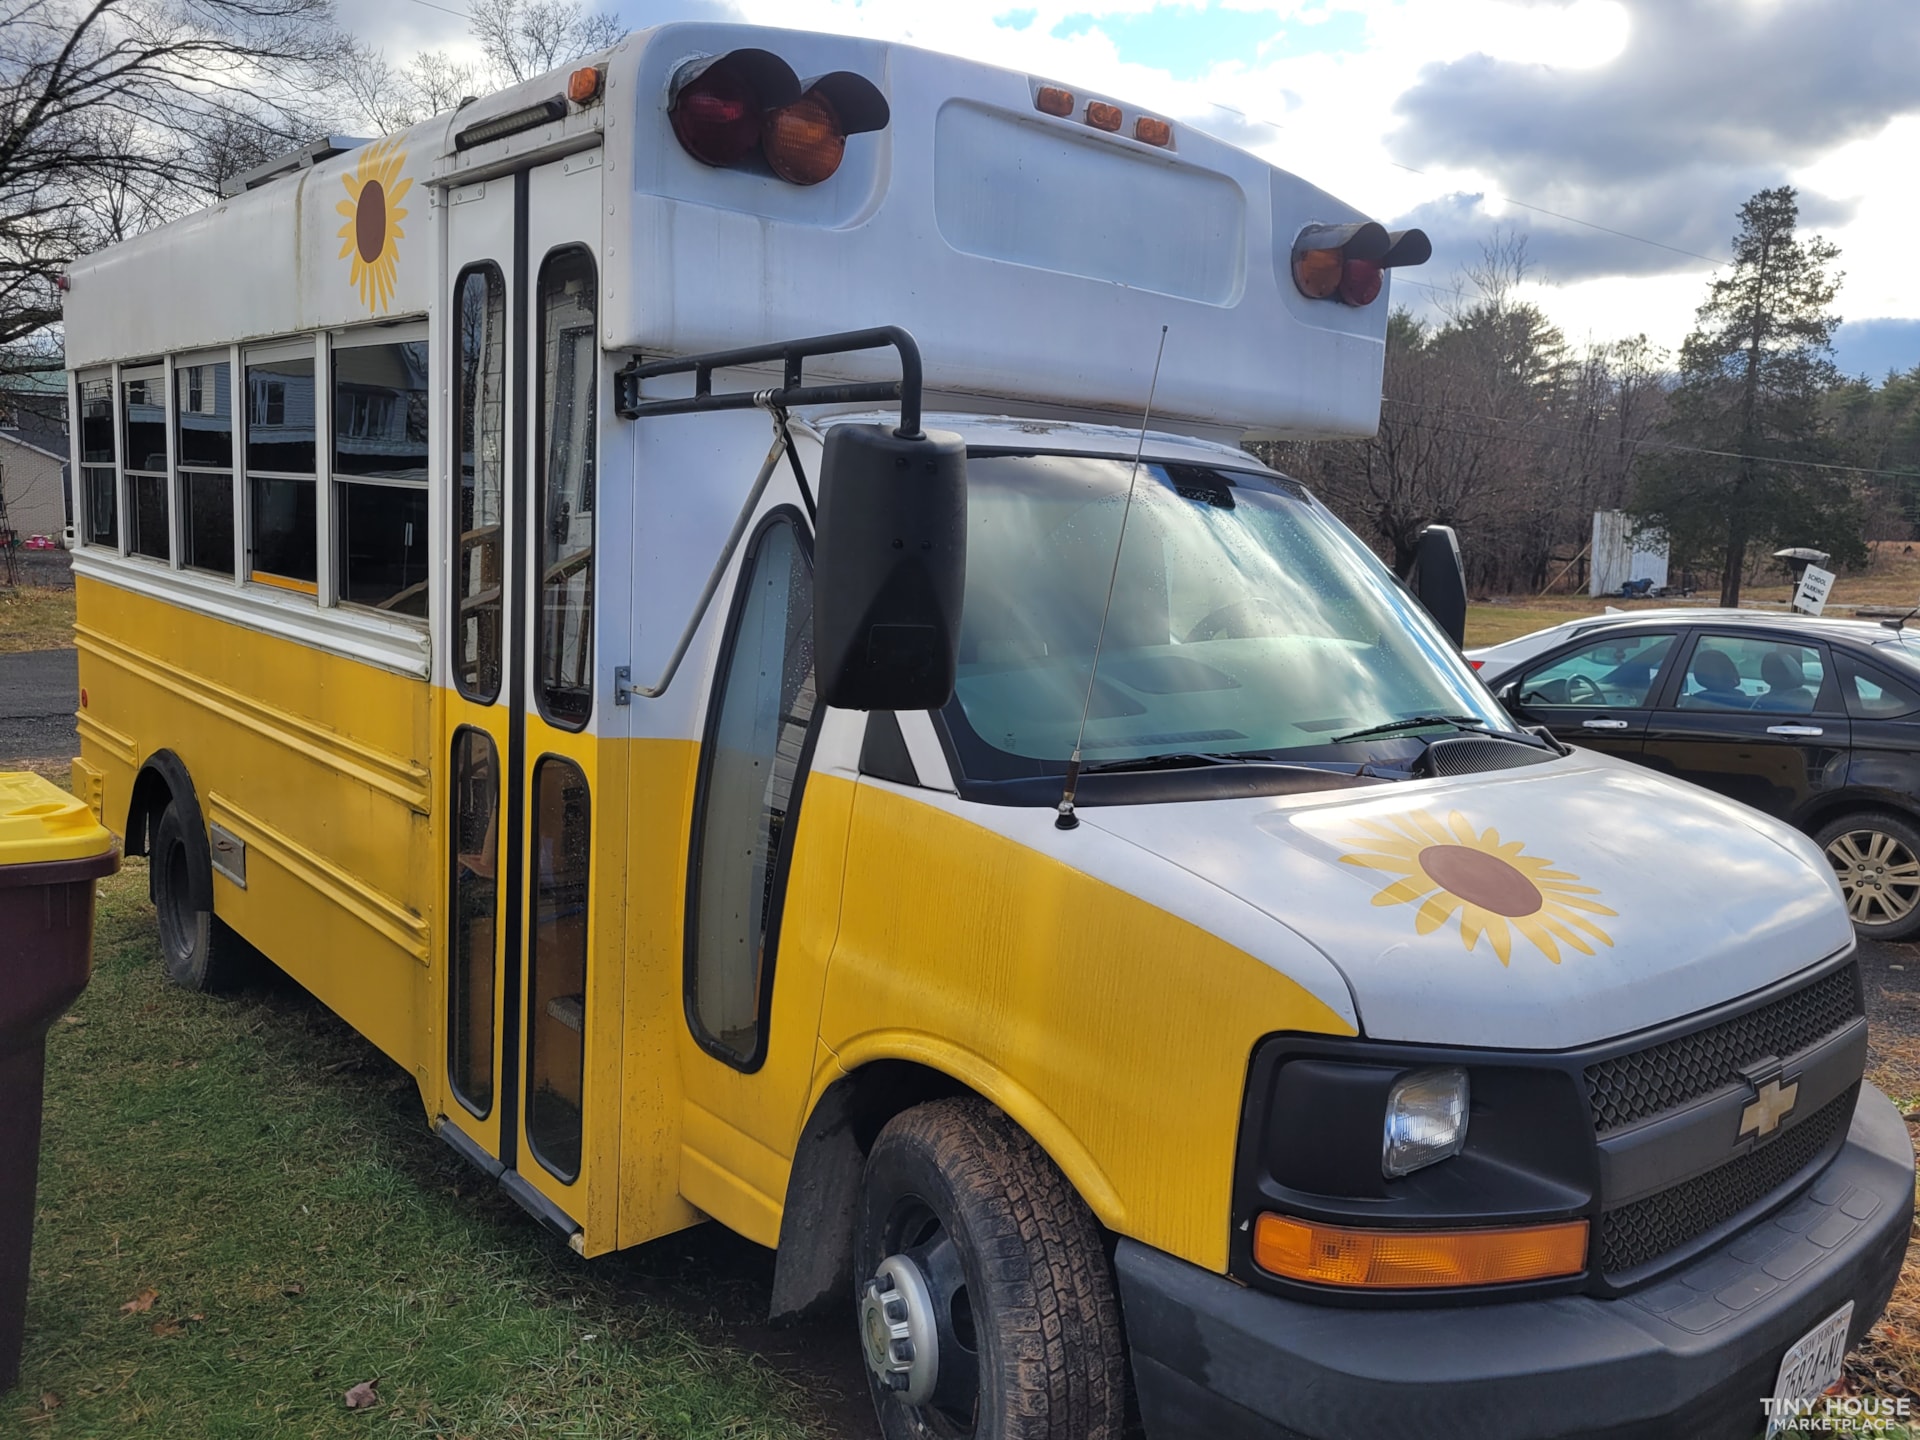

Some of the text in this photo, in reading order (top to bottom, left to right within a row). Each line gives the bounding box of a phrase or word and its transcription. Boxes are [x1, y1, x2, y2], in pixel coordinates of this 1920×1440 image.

[1808, 573, 1826, 586] SCHOOL
[1804, 583, 1824, 596] PARKING
[1801, 1323, 1835, 1355] NEW YORK
